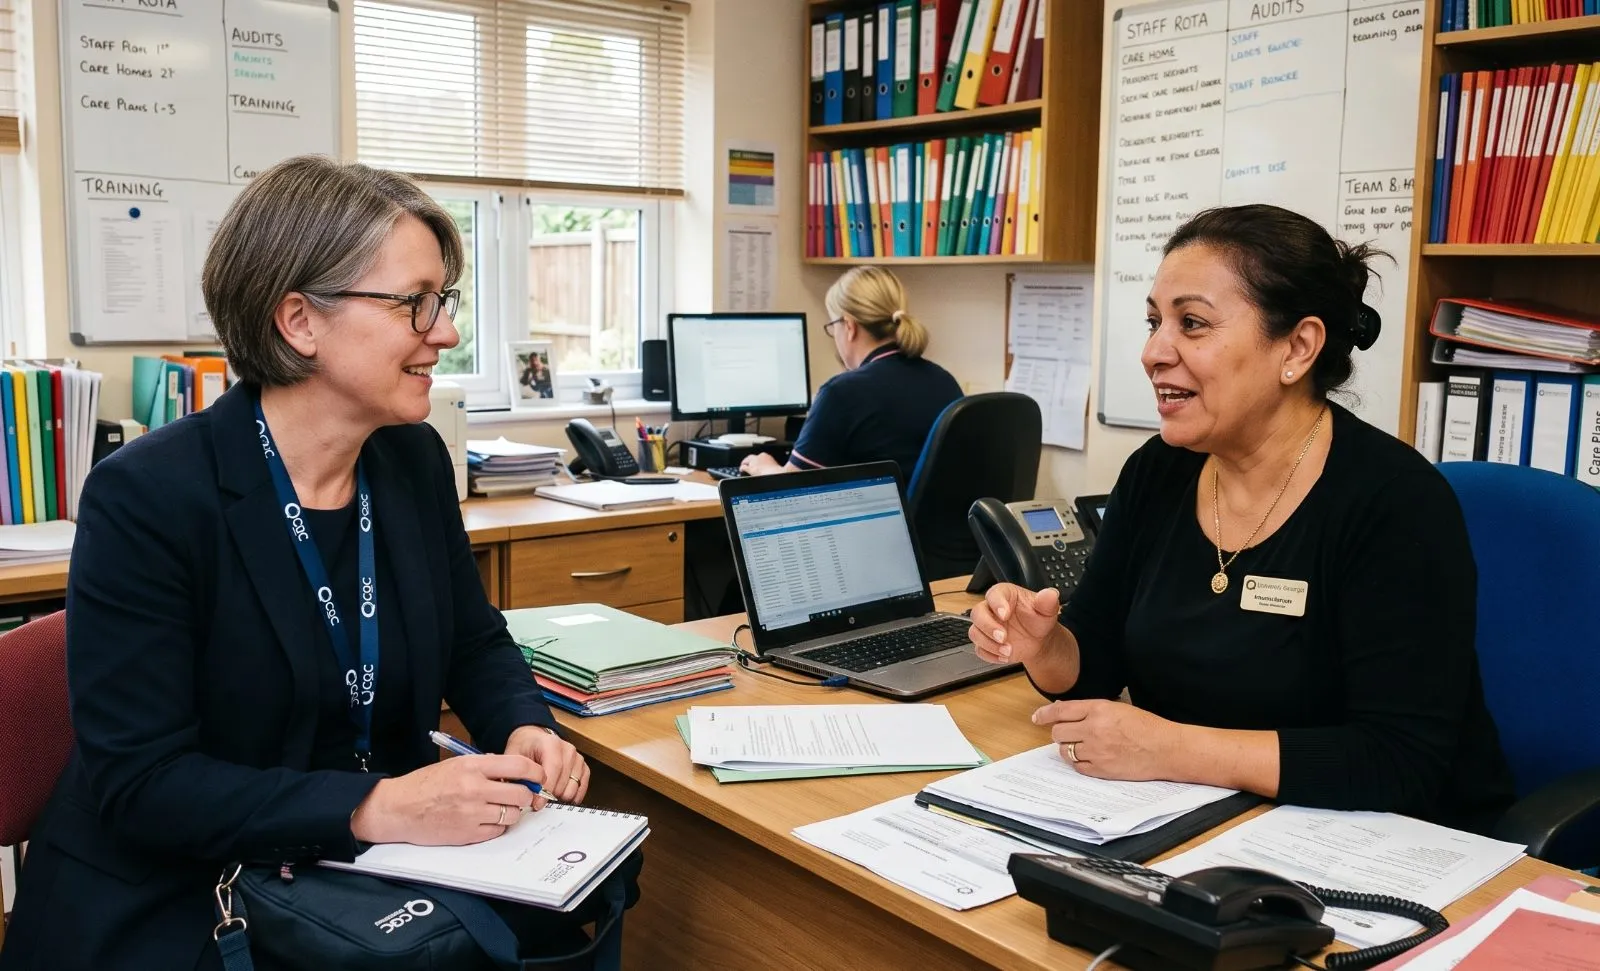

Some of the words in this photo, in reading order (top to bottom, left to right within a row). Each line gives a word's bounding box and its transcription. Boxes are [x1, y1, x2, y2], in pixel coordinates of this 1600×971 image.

[1250, 0, 1304, 20] AUDITS
[1127, 18, 1167, 39] STAFF
[1174, 12, 1208, 32] ROTA
[232, 27, 283, 47] AUDITS
[1122, 52, 1145, 65] CARE
[1149, 46, 1175, 60] HOME
[229, 94, 295, 113] TRAINING
[82, 177, 164, 198] TRAINING
[1345, 178, 1383, 194] TEAM
[1588, 446, 1600, 476] Care
